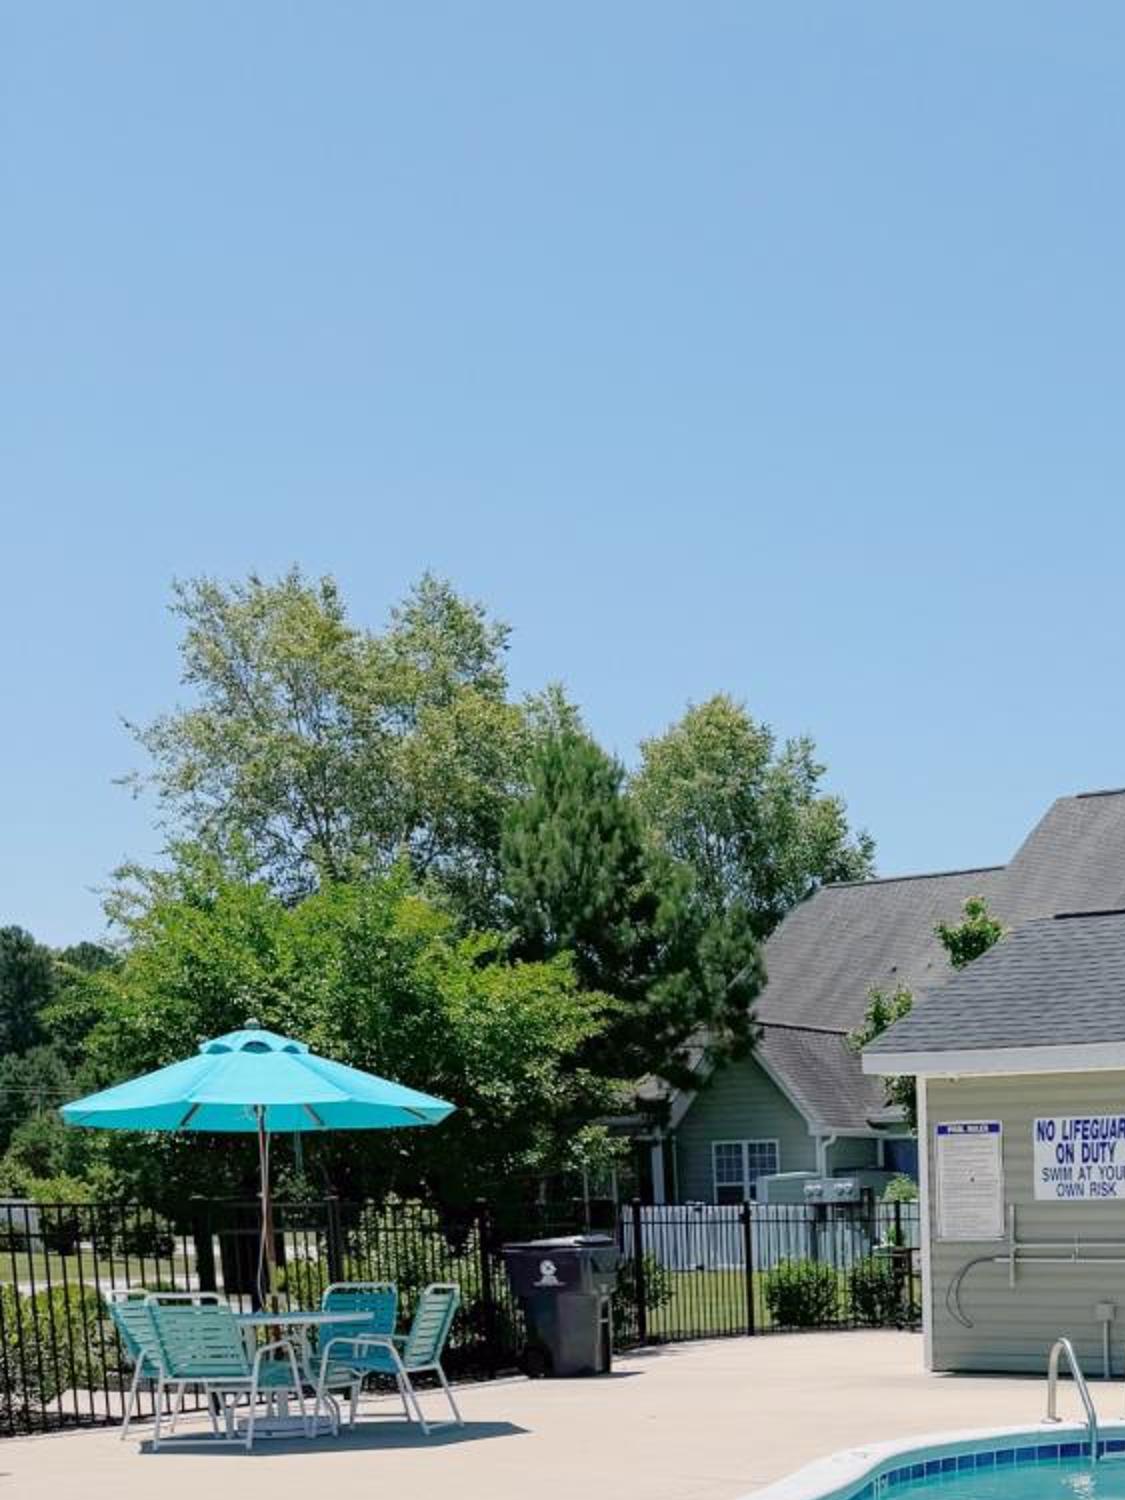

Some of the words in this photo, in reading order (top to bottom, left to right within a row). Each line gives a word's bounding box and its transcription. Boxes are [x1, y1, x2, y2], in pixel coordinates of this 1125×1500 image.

[1037, 1119, 1055, 1141] NO
[1056, 1143, 1074, 1164] ON
[1082, 1141, 1116, 1163] DUTY
[1041, 1166, 1073, 1182] SWIM
[1078, 1165, 1092, 1181] AT
[1056, 1183, 1084, 1197] OWN
[1090, 1181, 1117, 1197] RISK
